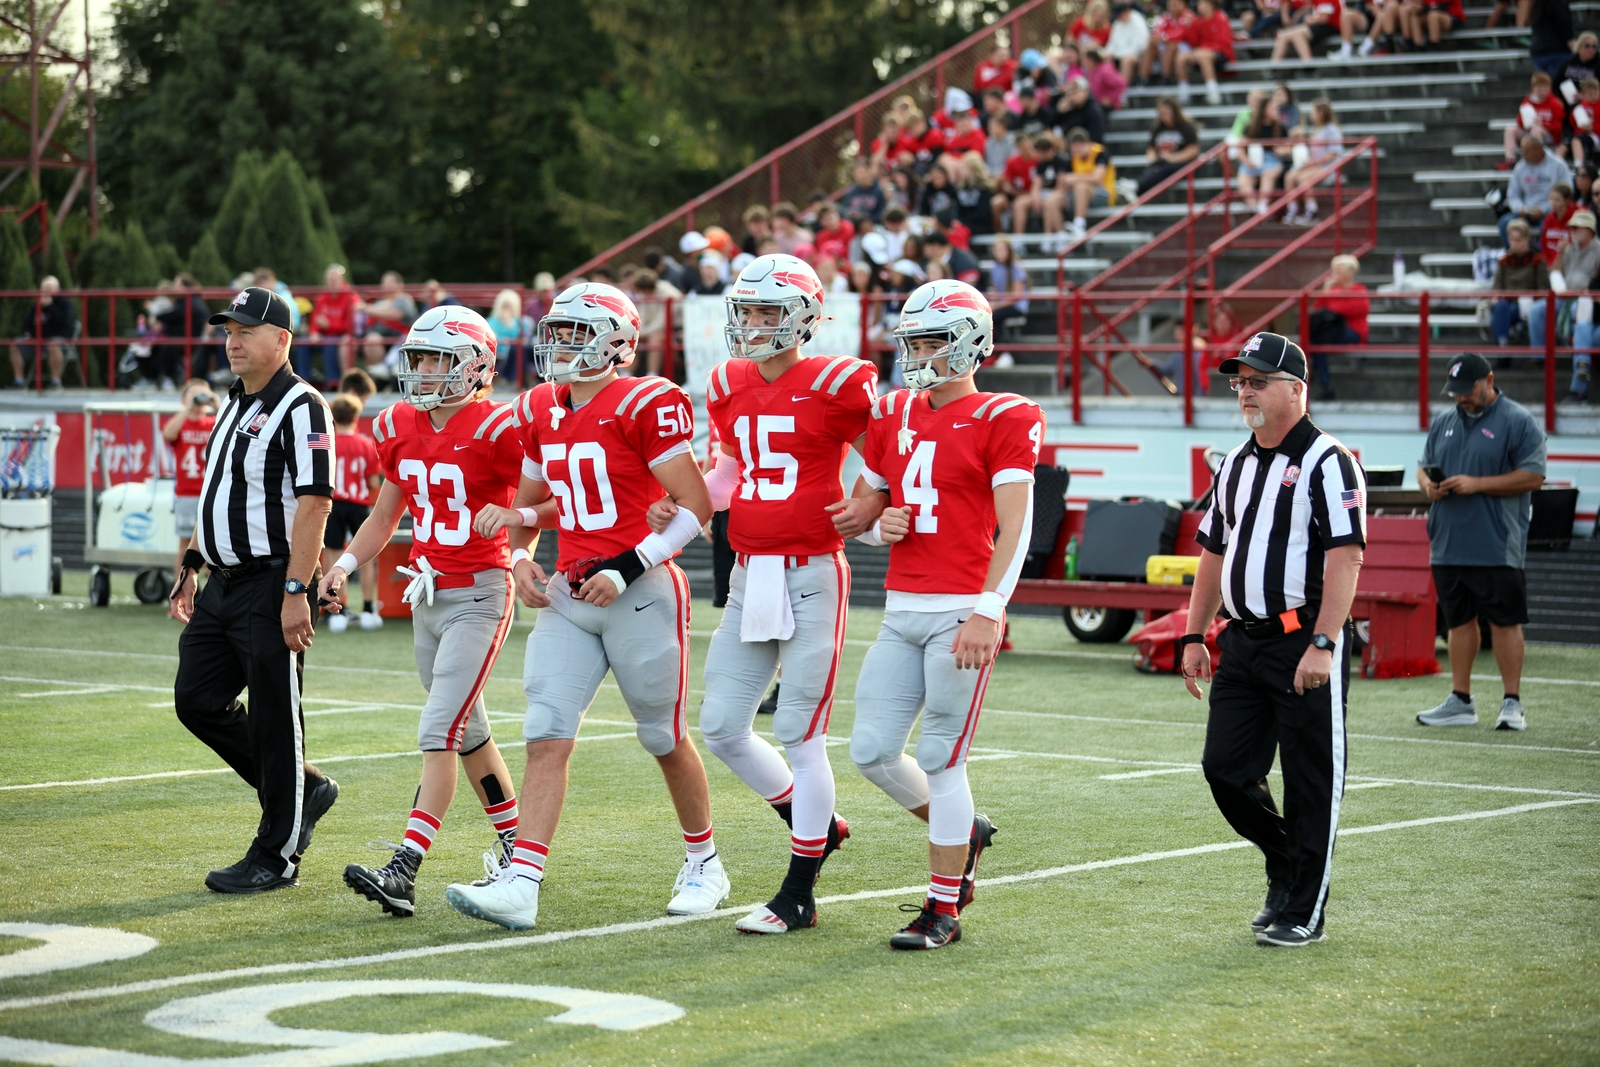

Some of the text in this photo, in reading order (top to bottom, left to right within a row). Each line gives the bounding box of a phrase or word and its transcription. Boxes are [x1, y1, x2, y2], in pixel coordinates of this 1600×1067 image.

[89, 428, 147, 475] First
[656, 402, 692, 438] 50
[733, 414, 799, 501] 15
[1028, 420, 1042, 456] 4
[398, 458, 472, 547] 33
[541, 441, 618, 532] 50
[901, 440, 939, 534] 4
